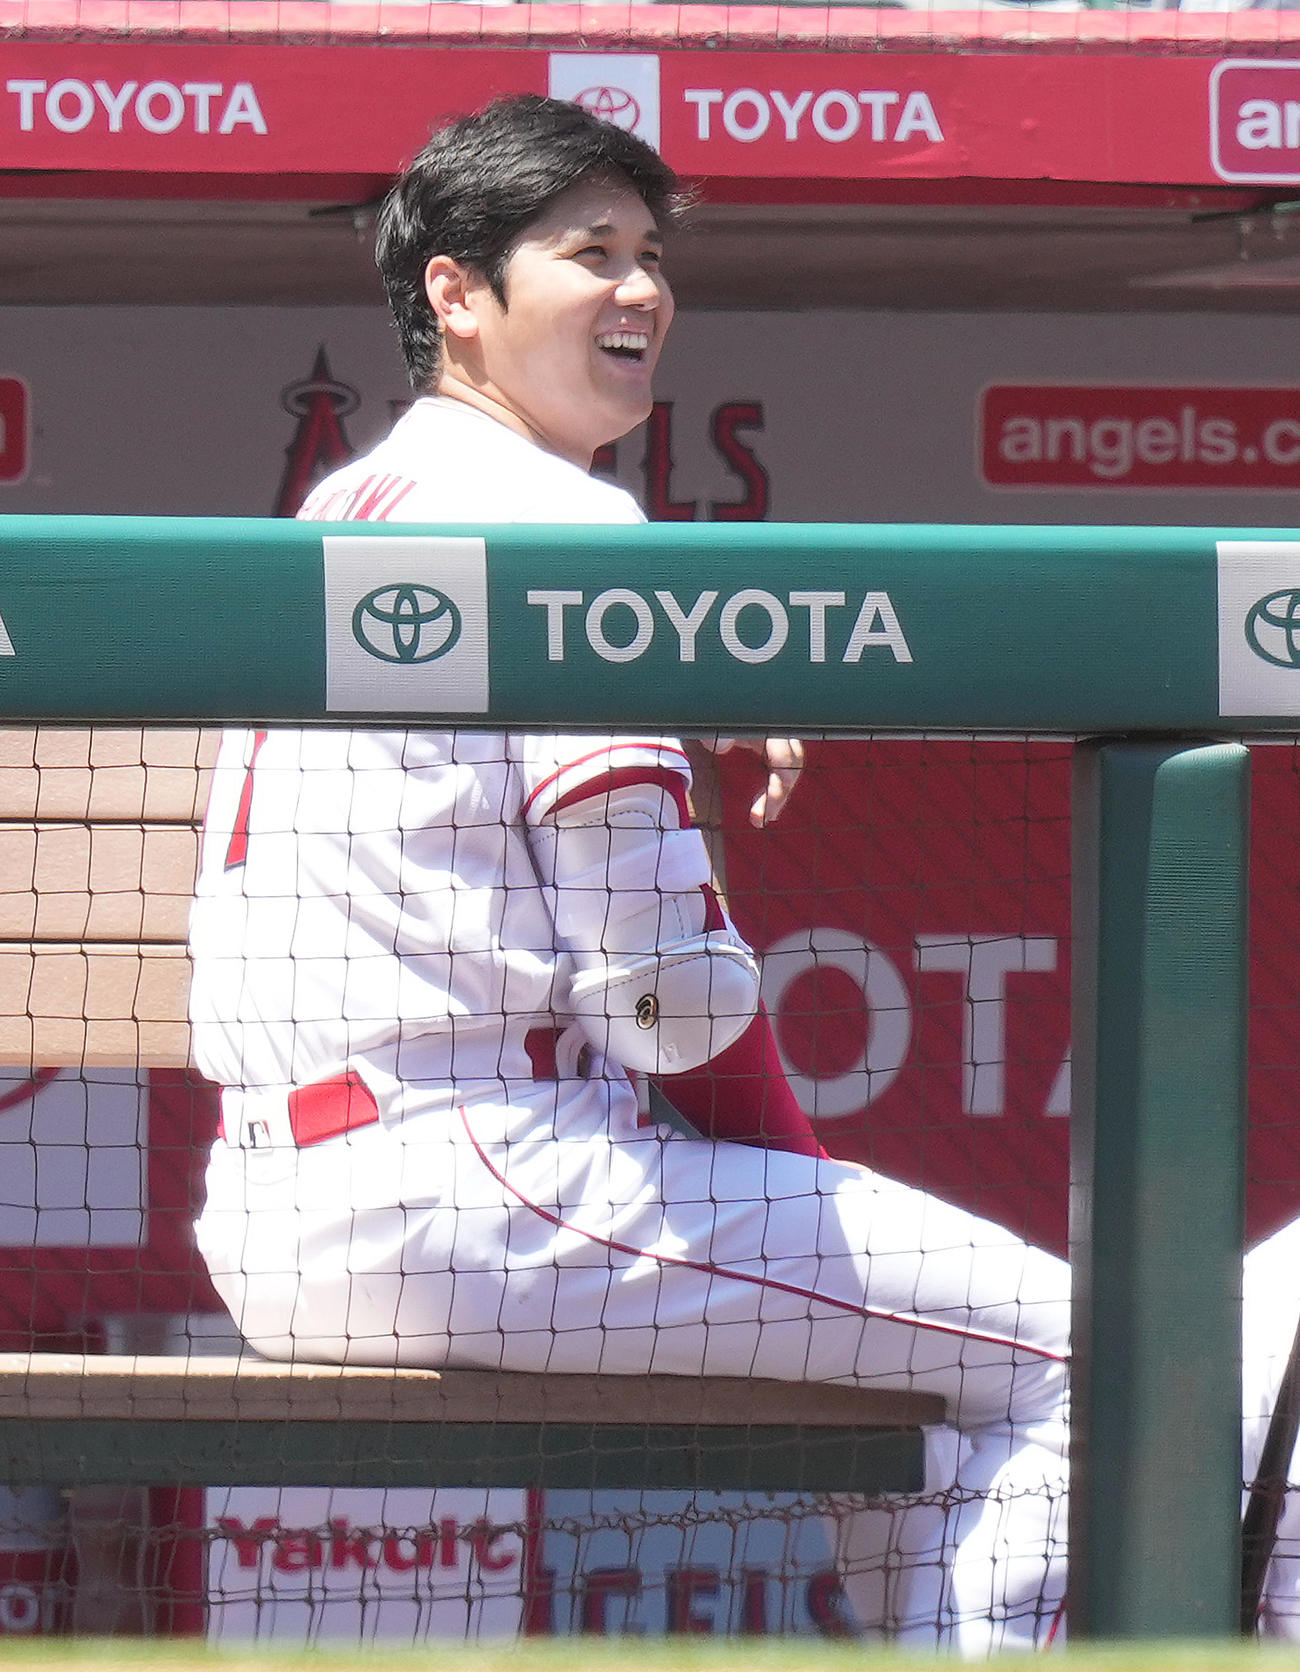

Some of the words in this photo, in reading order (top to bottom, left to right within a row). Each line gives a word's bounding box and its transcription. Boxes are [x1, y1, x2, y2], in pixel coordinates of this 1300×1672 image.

[7, 78, 268, 135] TOYOTA
[684, 88, 945, 143] TOYOTA
[526, 588, 914, 664] TOYOTA
[214, 1516, 516, 1574] Yakult
